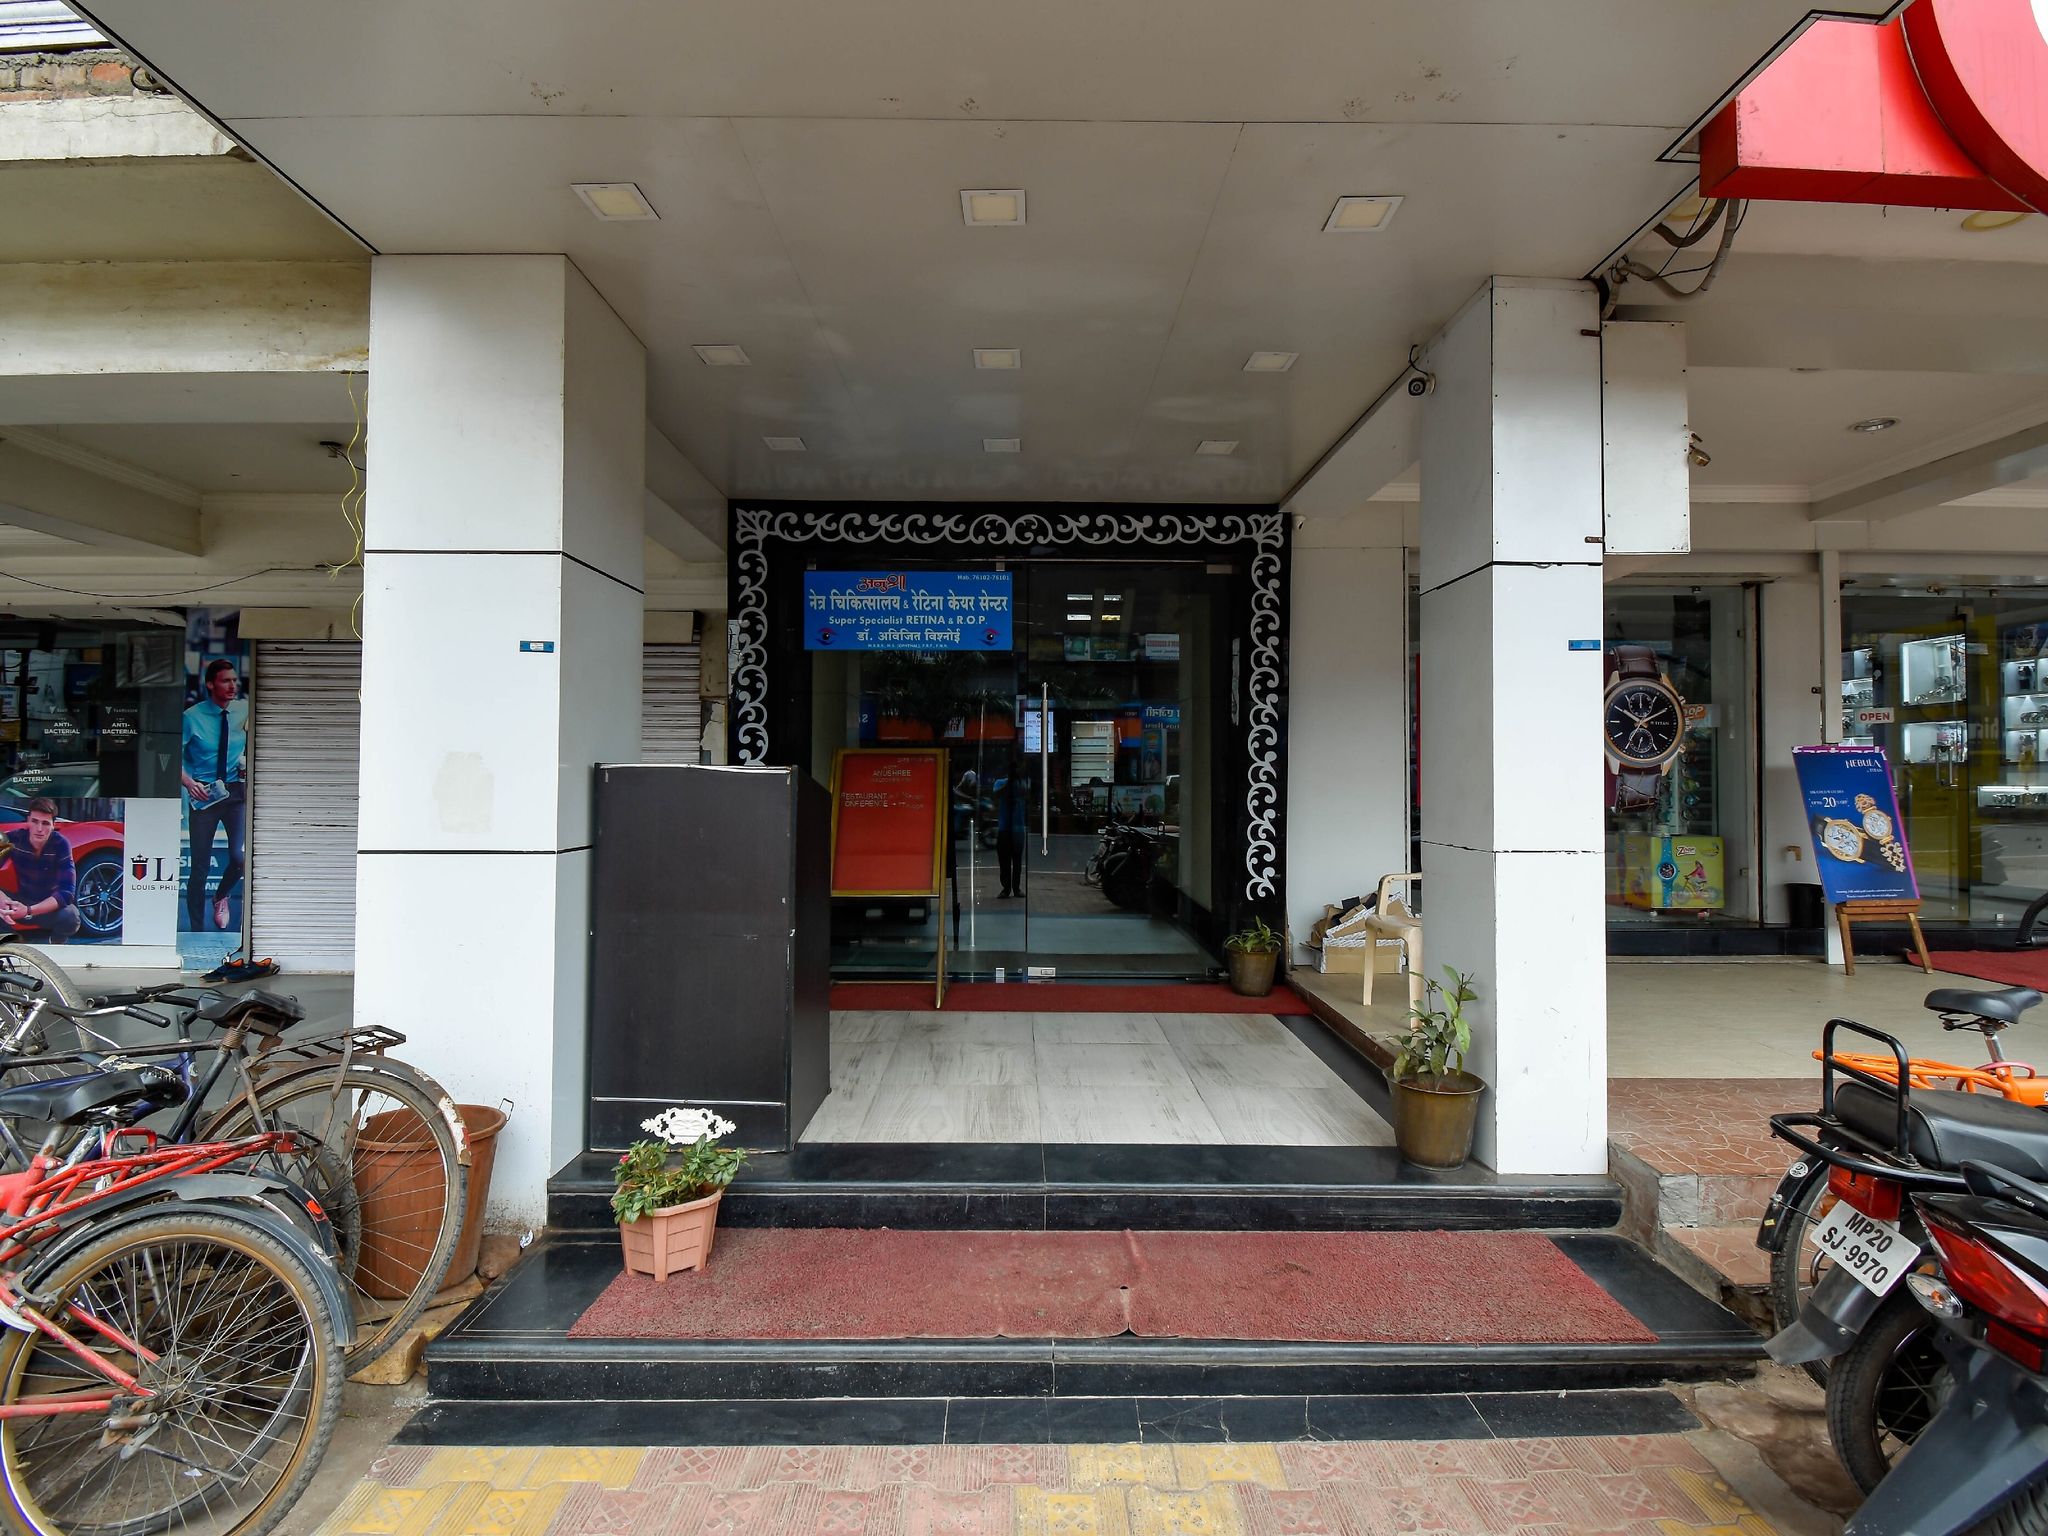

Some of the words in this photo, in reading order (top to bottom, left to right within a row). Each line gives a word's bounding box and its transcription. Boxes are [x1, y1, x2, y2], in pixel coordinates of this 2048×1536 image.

[857, 574, 906, 593] अनुश्री
[808, 589, 826, 610] नेत्र
[829, 589, 901, 610] चिकित्सालय
[903, 600, 909, 609] &
[911, 589, 944, 611] रेटिना
[947, 589, 975, 611] केयर
[978, 590, 1008, 611] सेन्टर
[829, 616, 856, 626] Super
[860, 615, 903, 626] Specialist
[906, 616, 945, 624] RETINA
[956, 616, 988, 624] R.O.P.
[856, 628, 873, 641] डॉ.
[878, 628, 921, 641] अविजित
[924, 628, 961, 643] विश्नोई
[1860, 713, 1890, 721] OPEN
[1845, 758, 1882, 768] NEBULA
[1845, 1212, 1893, 1253] MP20
